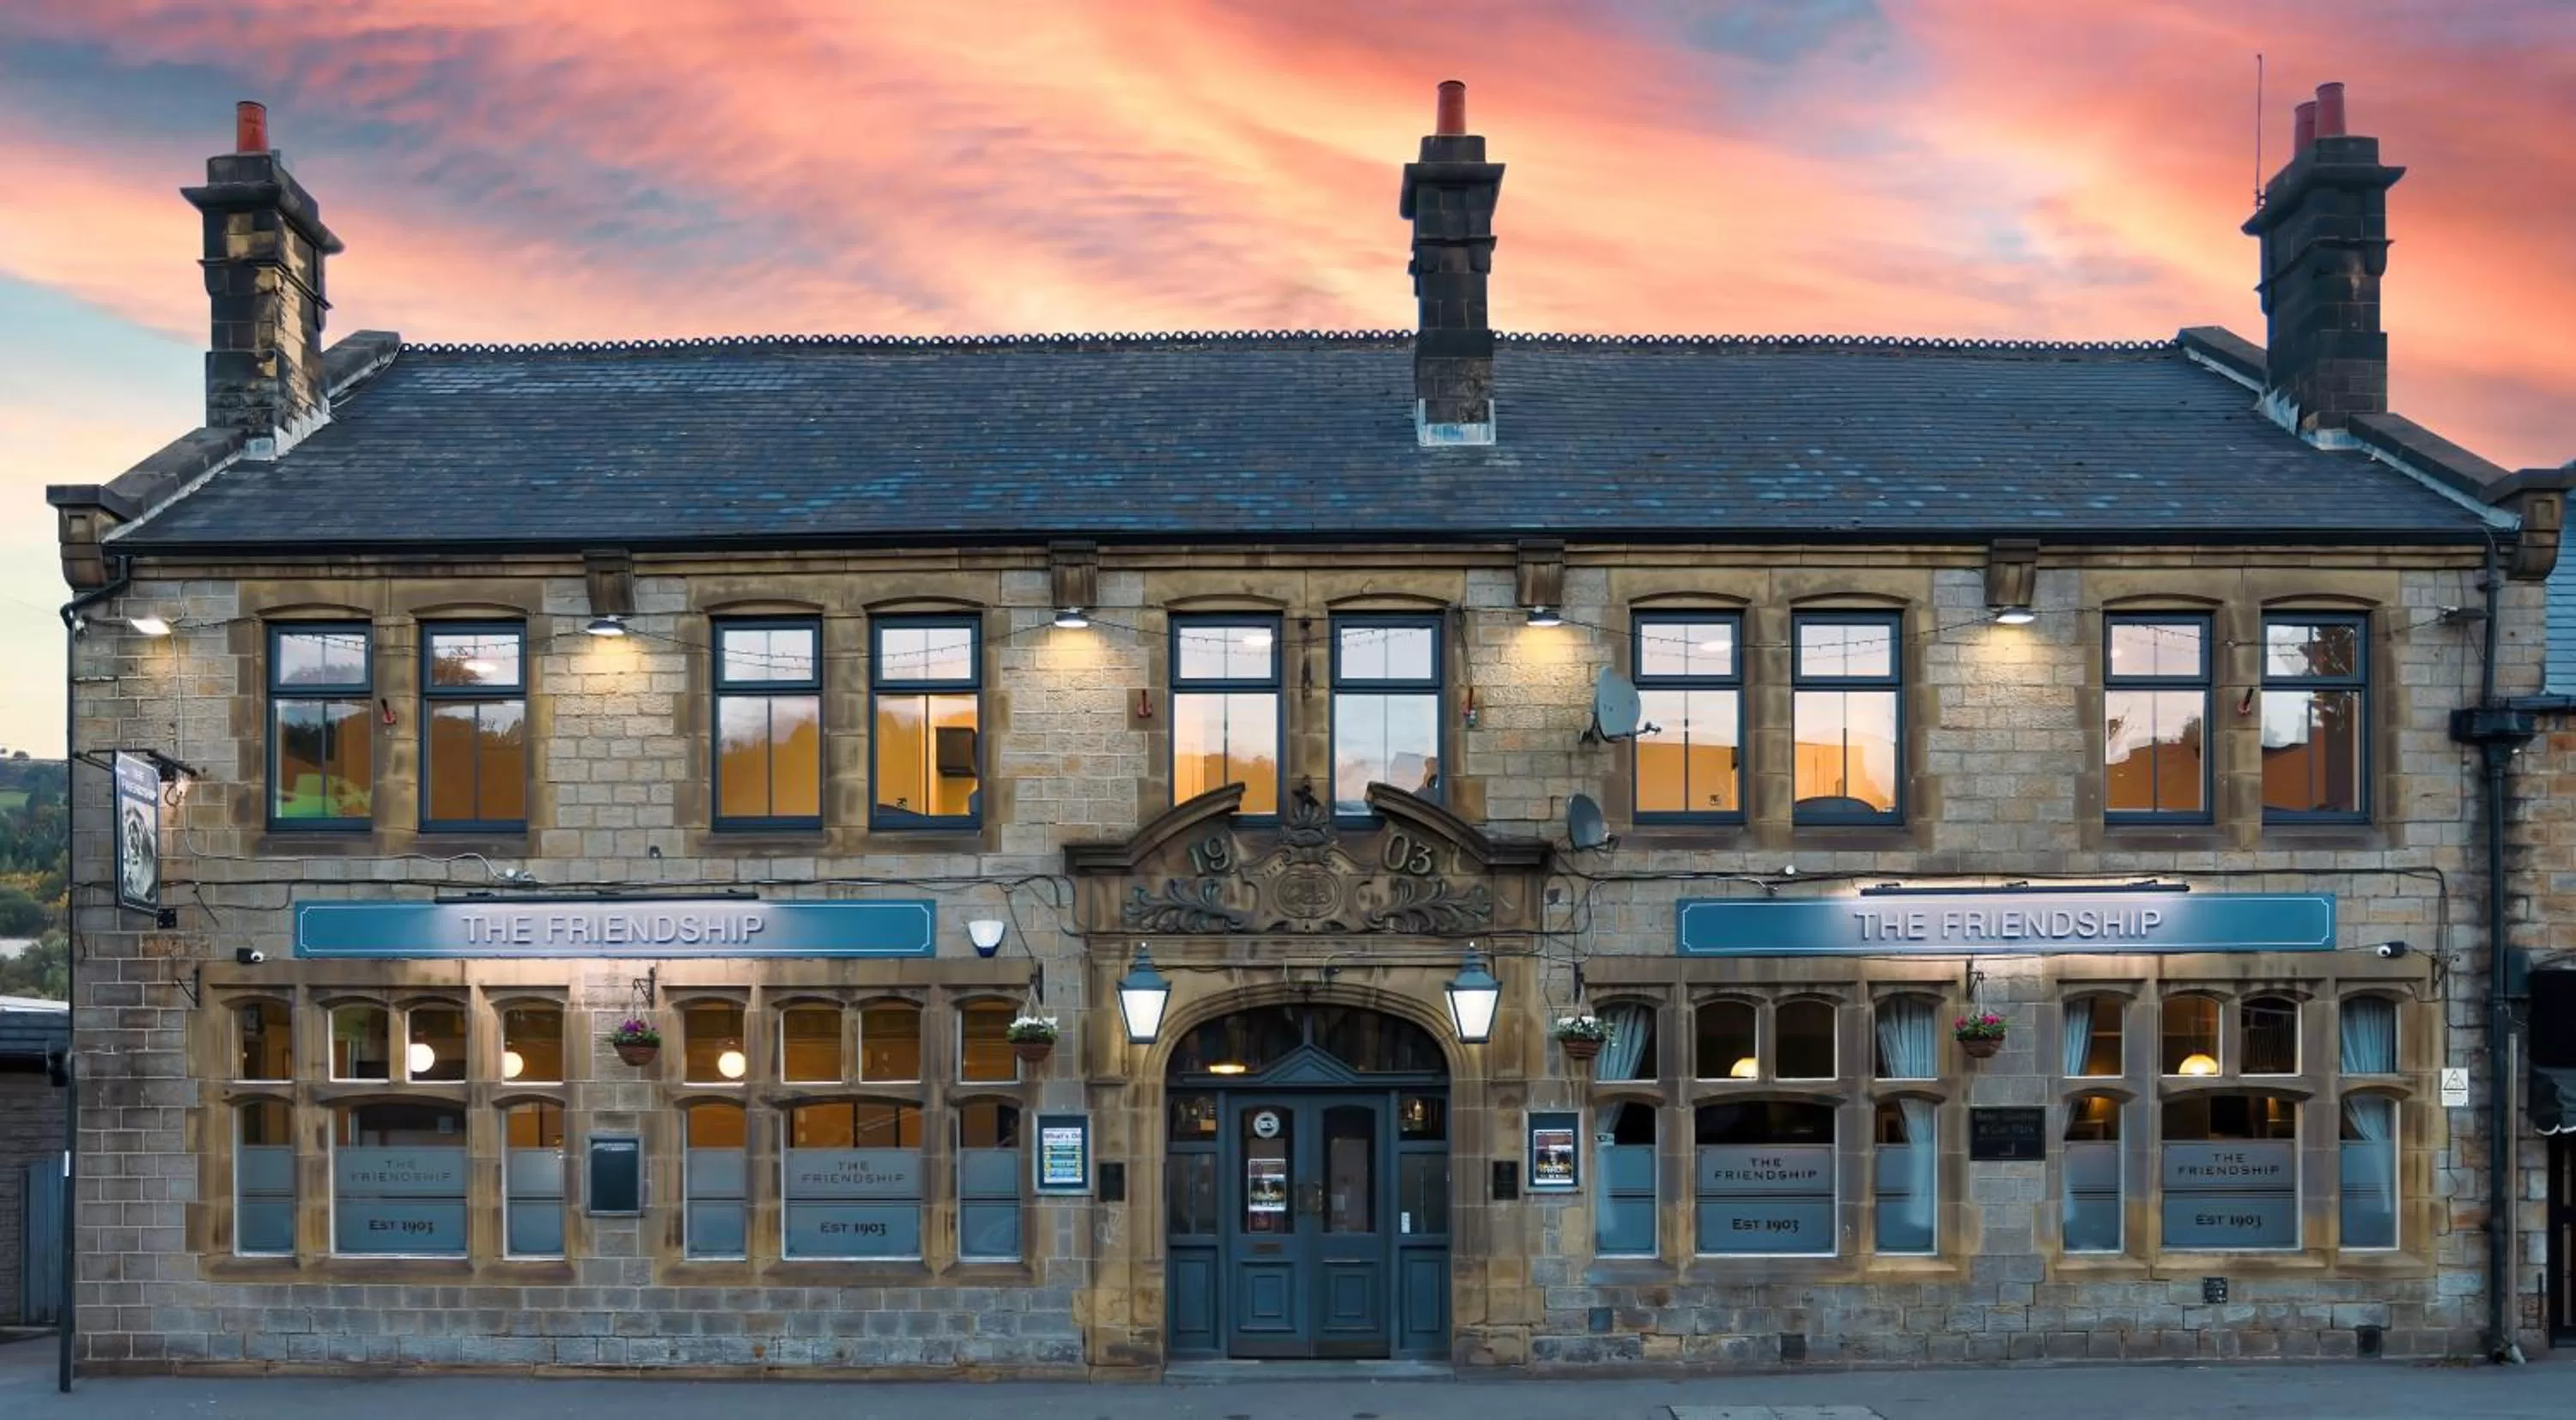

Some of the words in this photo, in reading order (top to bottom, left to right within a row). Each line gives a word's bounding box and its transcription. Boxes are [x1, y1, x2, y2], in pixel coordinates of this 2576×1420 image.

[1188, 836, 1231, 874] 19
[1382, 832, 1434, 876] 03
[461, 915, 532, 944] THE
[545, 914, 766, 944] FRIENDSHIP
[1854, 911, 1927, 941] THE
[1941, 908, 2162, 939] FRIENDSHIP
[1750, 1157, 1782, 1168] THE
[2213, 1153, 2246, 1163] THE
[385, 1160, 416, 1169] THE
[837, 1161, 870, 1171] THE
[2178, 1165, 2281, 1175] FRIENDSHIP
[350, 1171, 452, 1182] FRIENDSHIP
[800, 1173, 906, 1184] FRIENDSHIP
[1714, 1169, 1818, 1180] FRIENDSHIP
[854, 1222, 887, 1237] 1903
[1765, 1219, 1801, 1234] 1903
